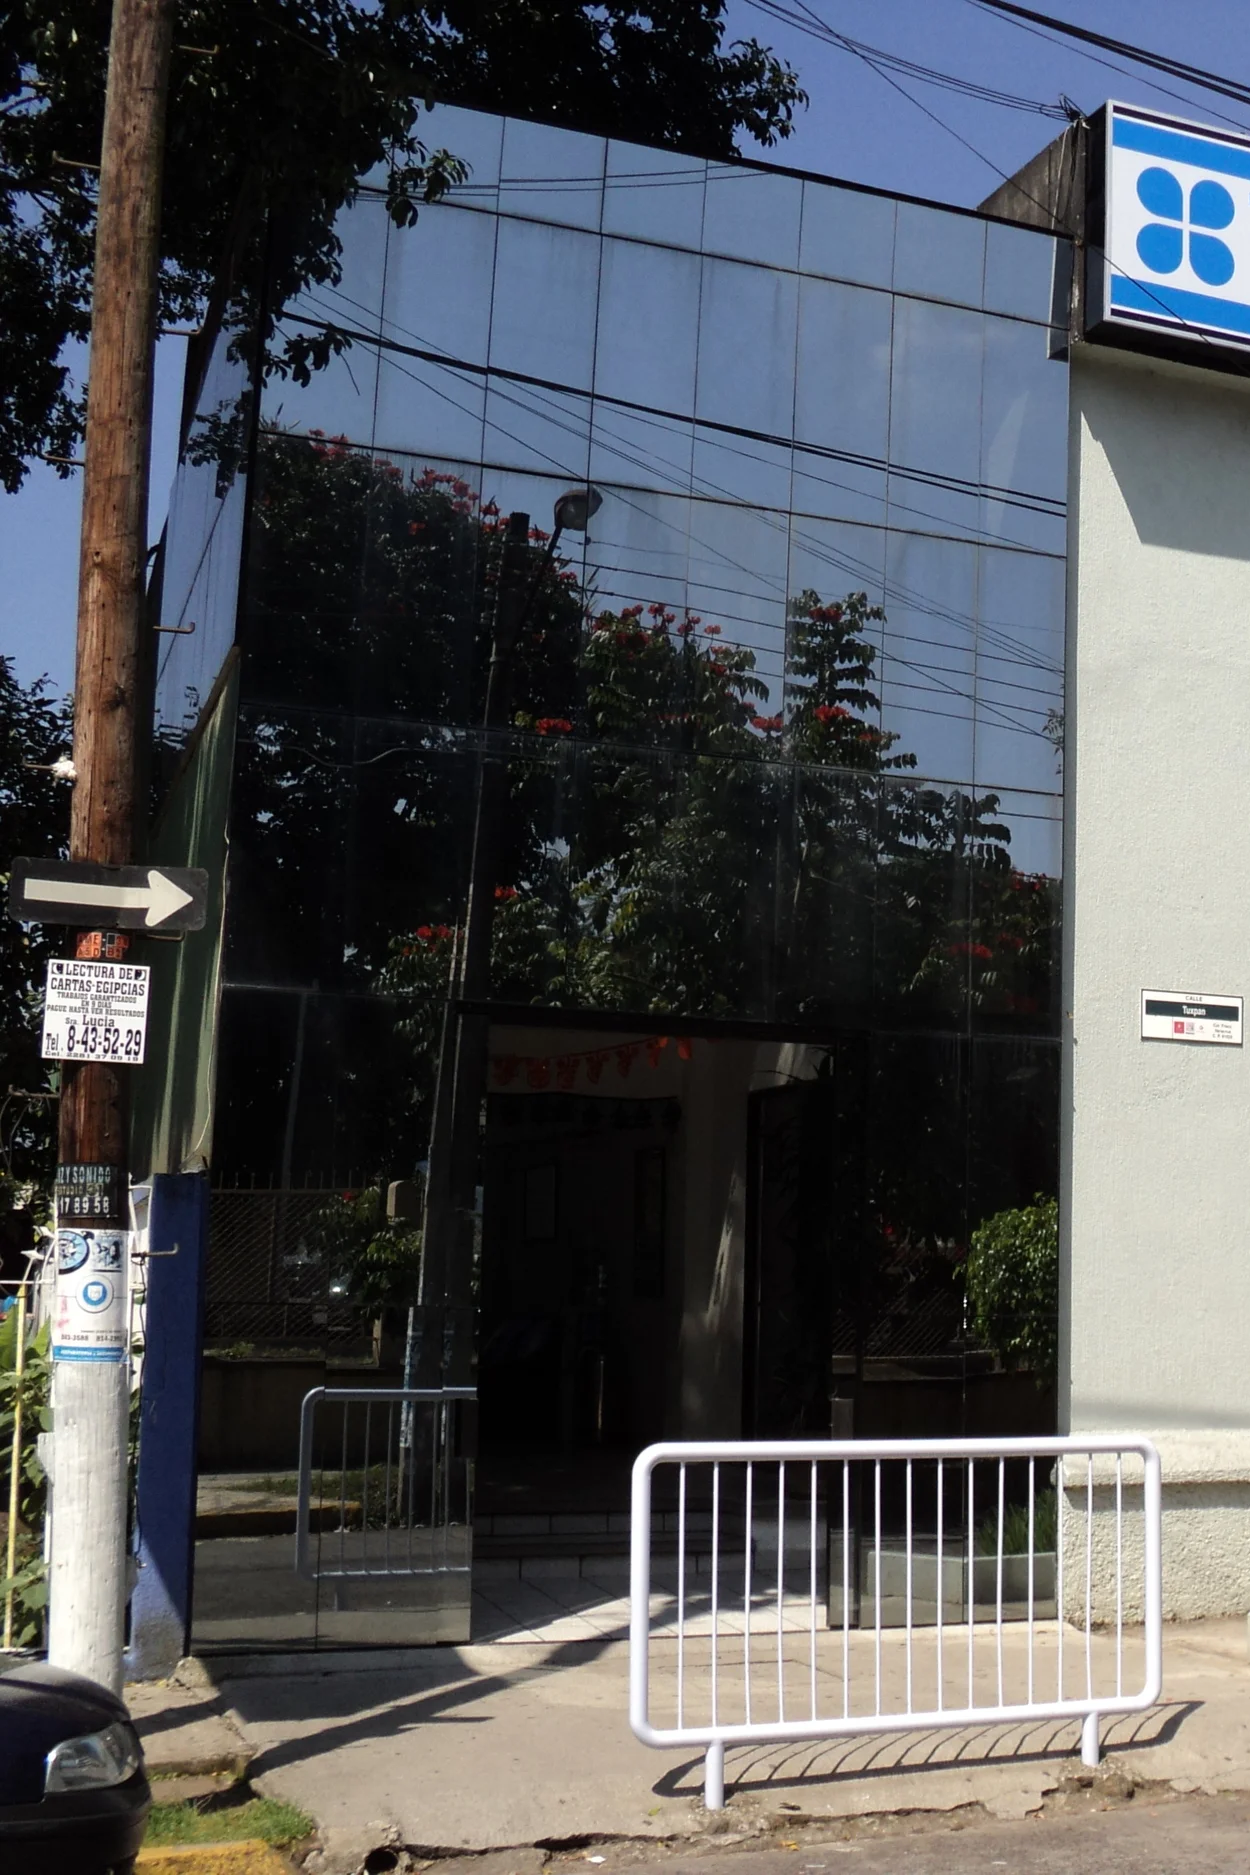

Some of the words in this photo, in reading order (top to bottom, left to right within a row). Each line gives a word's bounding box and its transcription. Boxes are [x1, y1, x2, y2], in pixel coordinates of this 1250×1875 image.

[66, 963, 115, 979] LECTURA
[118, 967, 133, 980] DE
[57, 991, 88, 1000] TRABAJOS
[90, 994, 136, 1003] GARANTIZADOS
[47, 1004, 67, 1012] PAGUE
[69, 1006, 89, 1014] HASTA
[105, 1008, 145, 1018] RESULTADOS
[67, 1025, 142, 1056] 8-43-52-29
[72, 1166, 110, 1184] SONIDO
